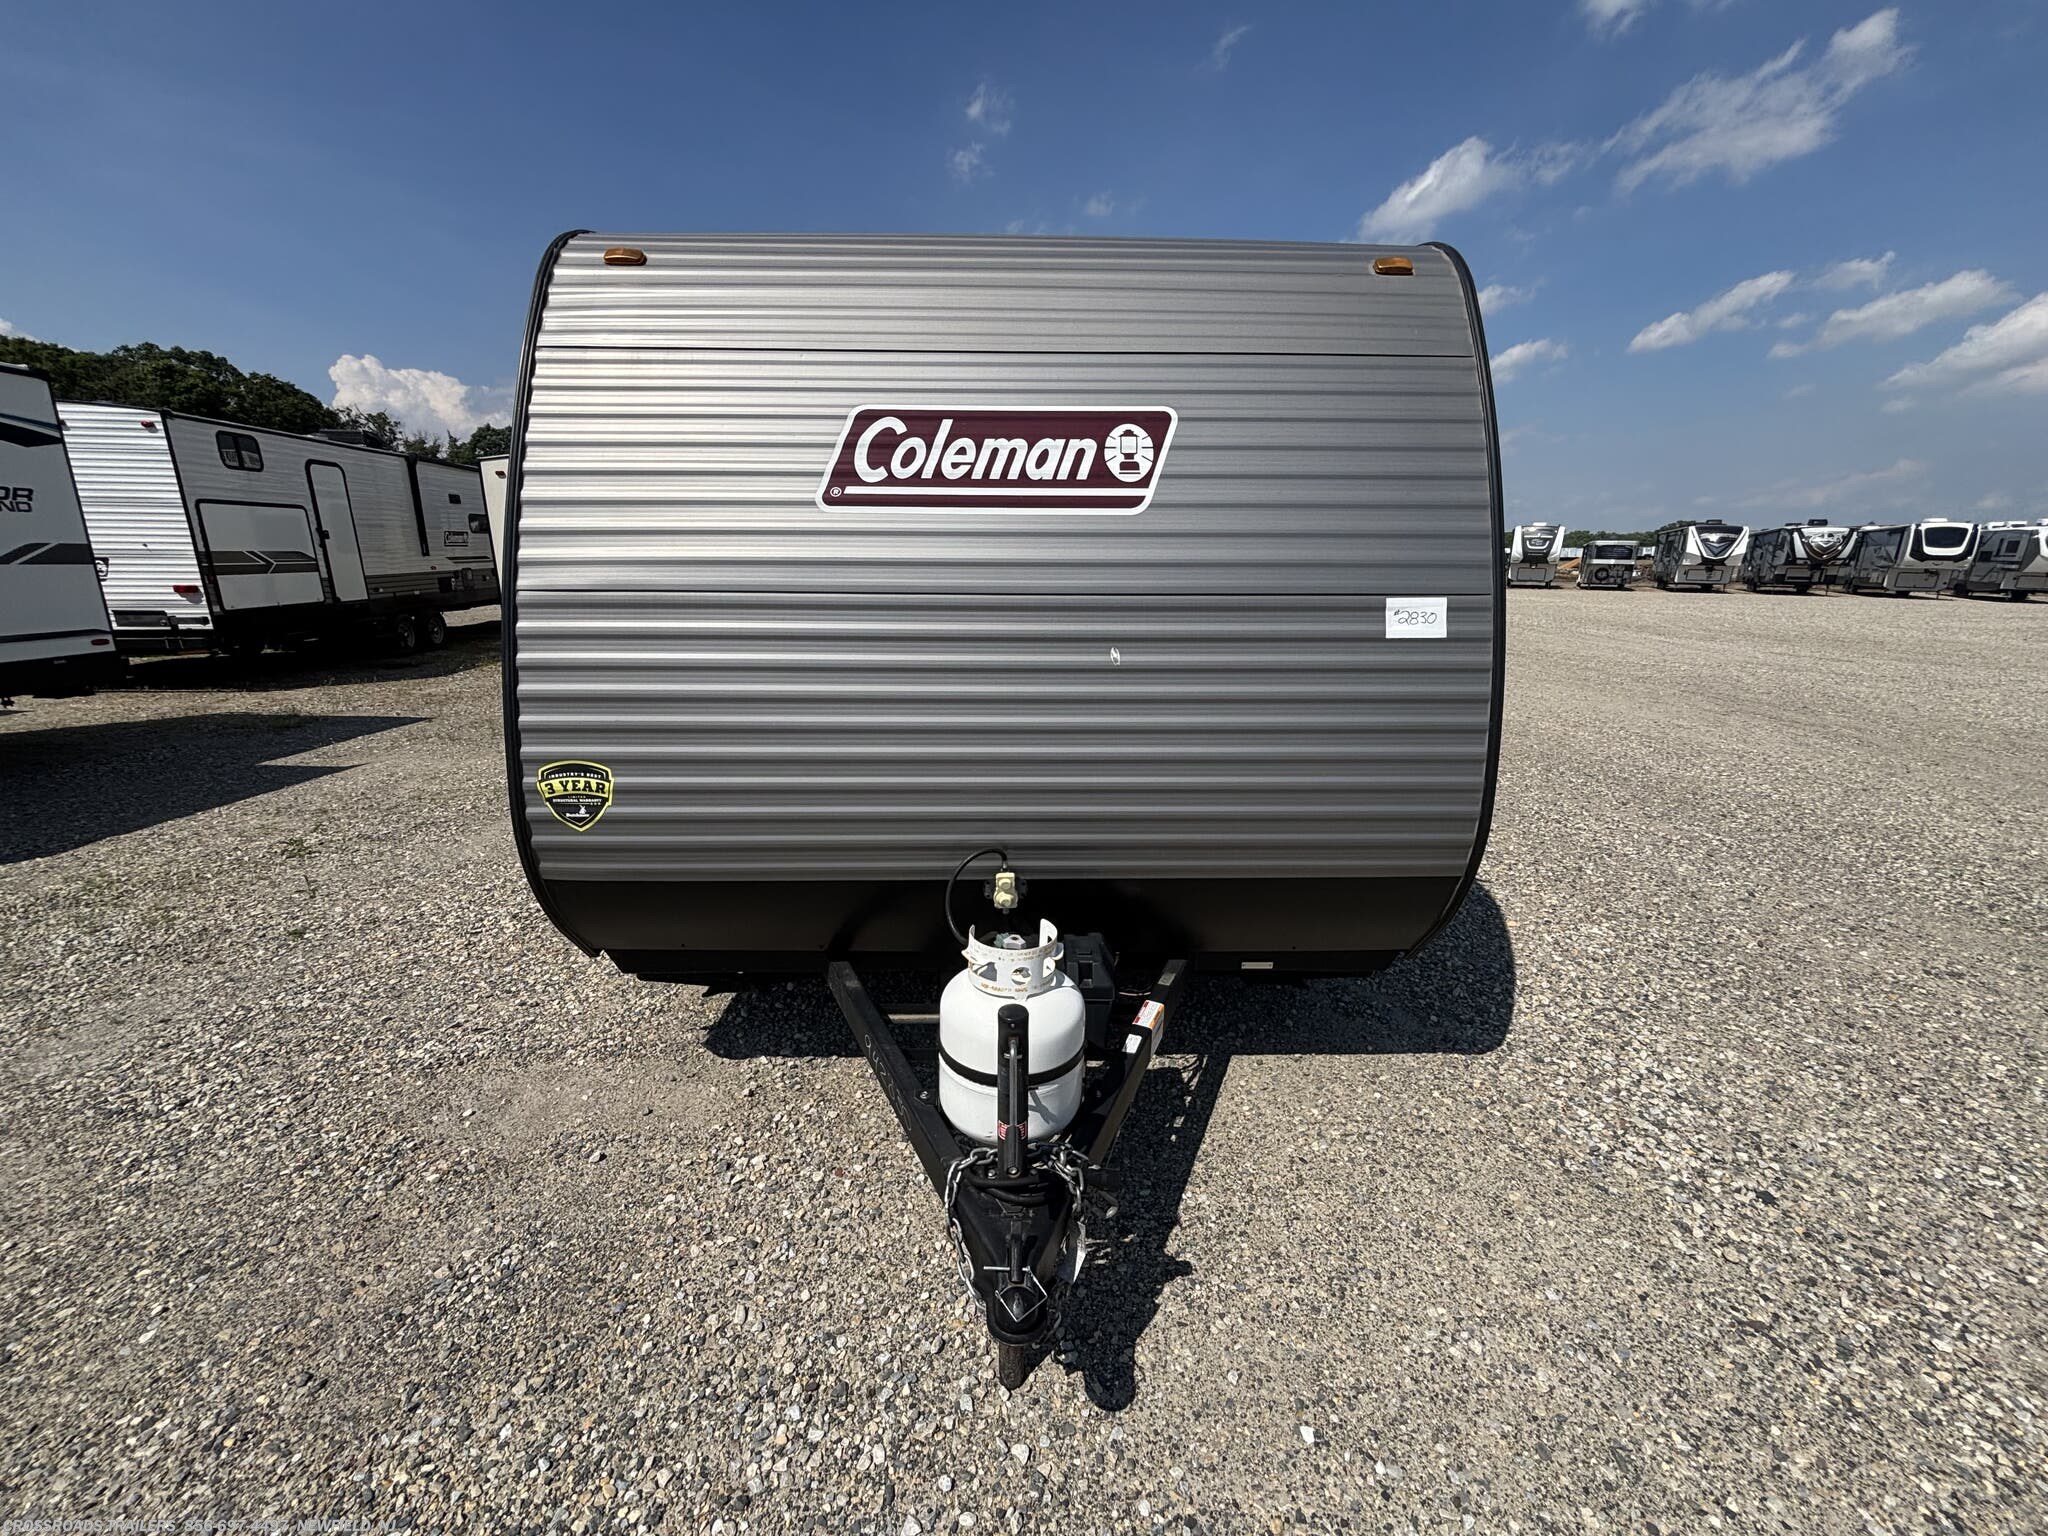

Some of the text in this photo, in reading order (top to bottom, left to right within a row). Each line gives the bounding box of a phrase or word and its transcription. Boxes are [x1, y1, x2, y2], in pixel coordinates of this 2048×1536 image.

[853, 416, 1098, 484] Coleman
[544, 780, 606, 795] 3 YEAR
